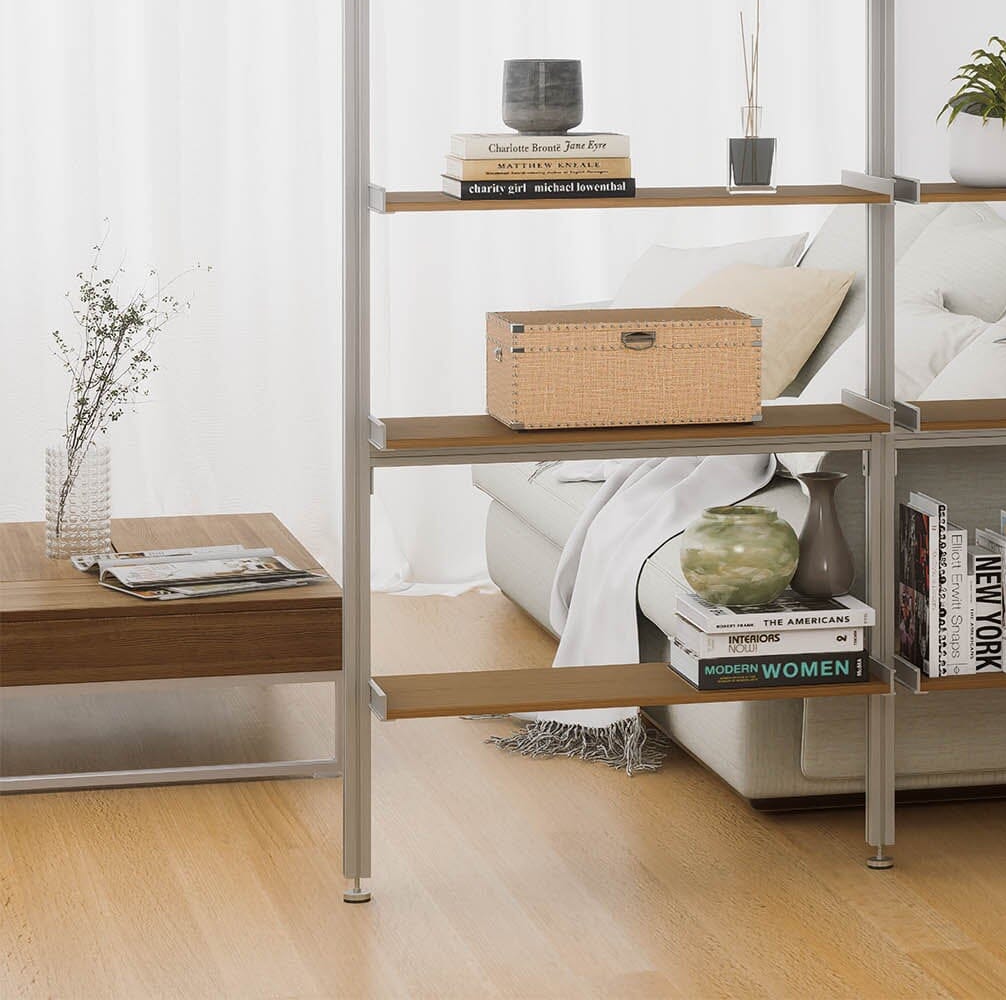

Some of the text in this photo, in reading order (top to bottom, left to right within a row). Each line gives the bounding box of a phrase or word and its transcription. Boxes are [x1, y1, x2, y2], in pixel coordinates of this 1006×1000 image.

[488, 140, 607, 153] Charlotte Brontë Jane Eyre
[469, 182, 626, 195] charity girl michael lowenthal
[949, 534, 962, 658] Elliott Erwitt Snaps
[787, 615, 850, 625] AMERICANS
[976, 557, 1002, 671] NEW YORK
[729, 634, 781, 644] INTERIORS
[836, 634, 848, 642] 2
[704, 664, 759, 676] MODERN
[762, 660, 849, 680] WOMEN
